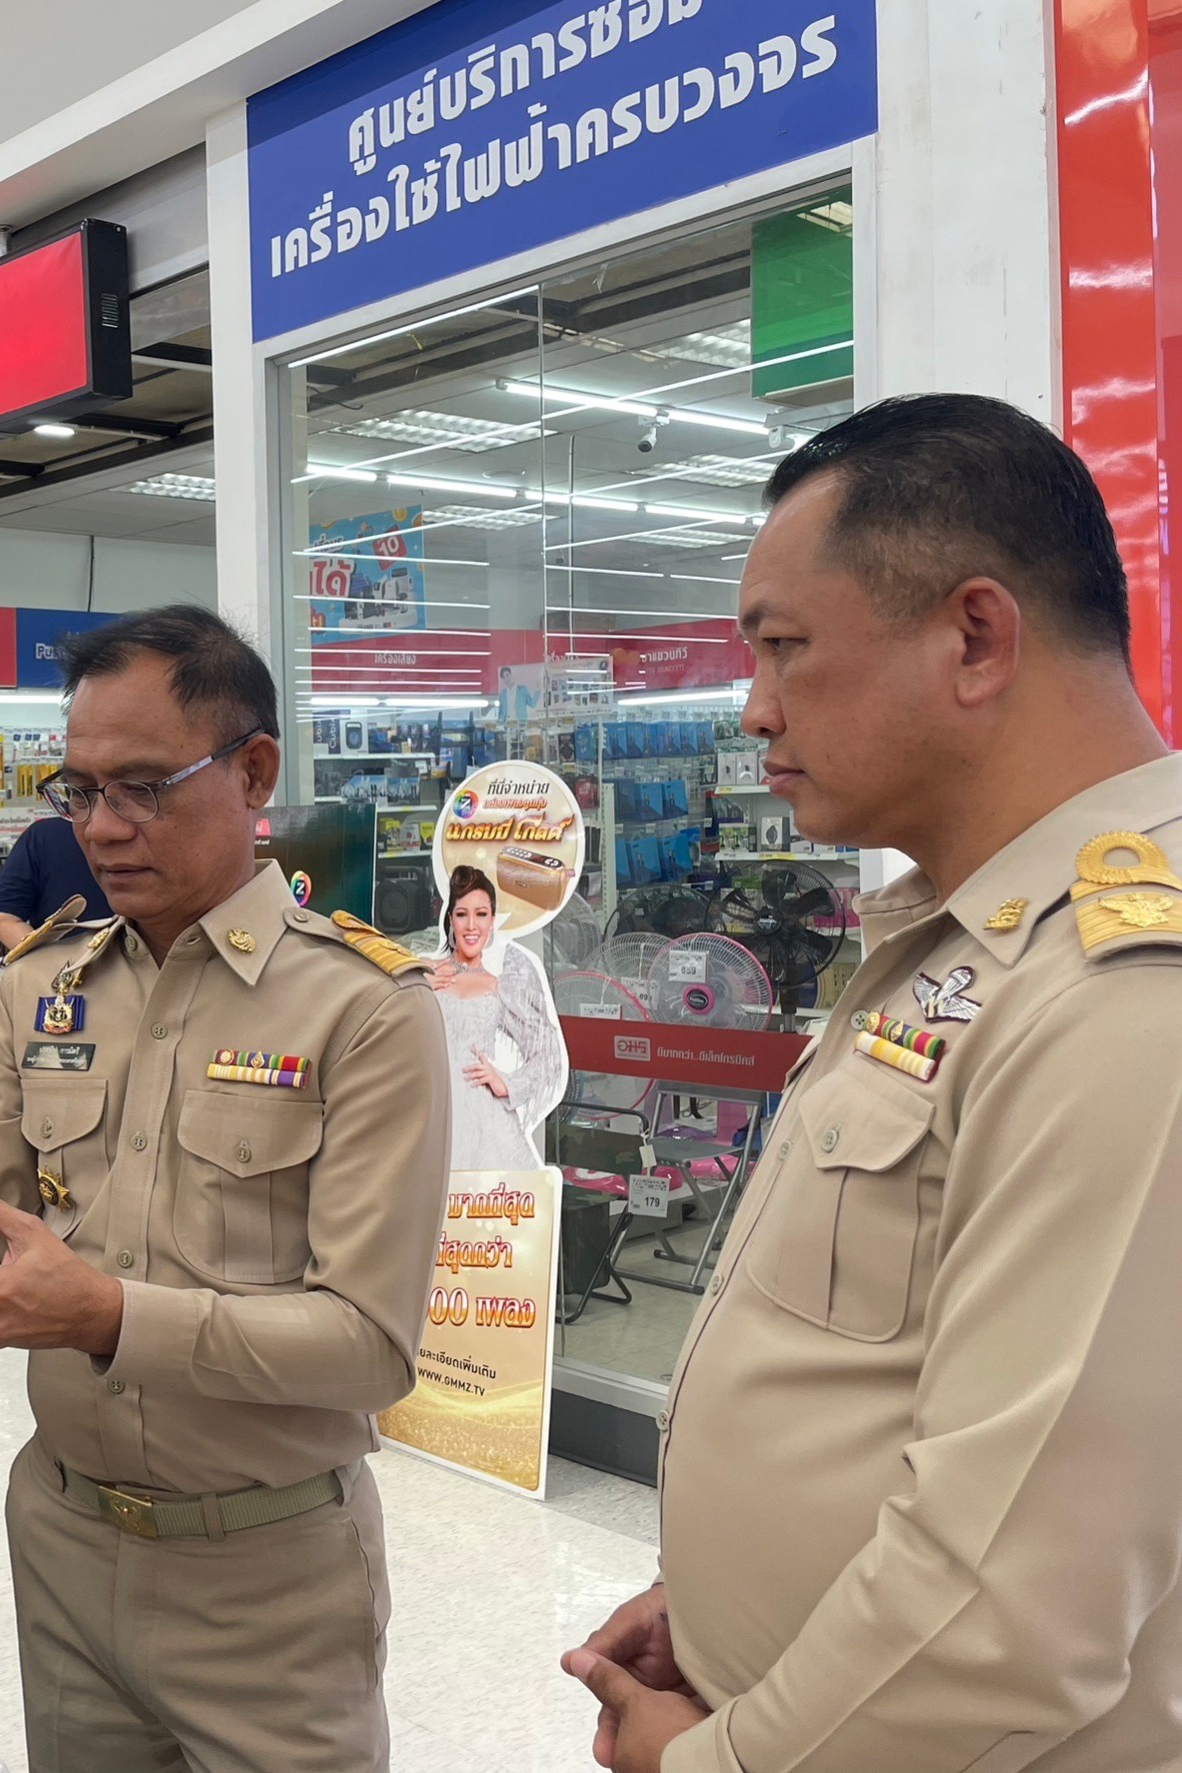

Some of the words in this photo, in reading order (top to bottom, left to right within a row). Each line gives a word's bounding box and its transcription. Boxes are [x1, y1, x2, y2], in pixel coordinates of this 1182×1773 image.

[271, 15, 837, 278] เครื่องใช้ไฟฟ้าครบวงจร
[487, 777, 550, 795] ที่นี่จำหน่าย
[645, 1196, 660, 1208] 179
[427, 1286, 470, 1326] 00
[475, 1296, 537, 1329] เพลง
[418, 1347, 497, 1380] ยละเอียดเพิ่มเติม
